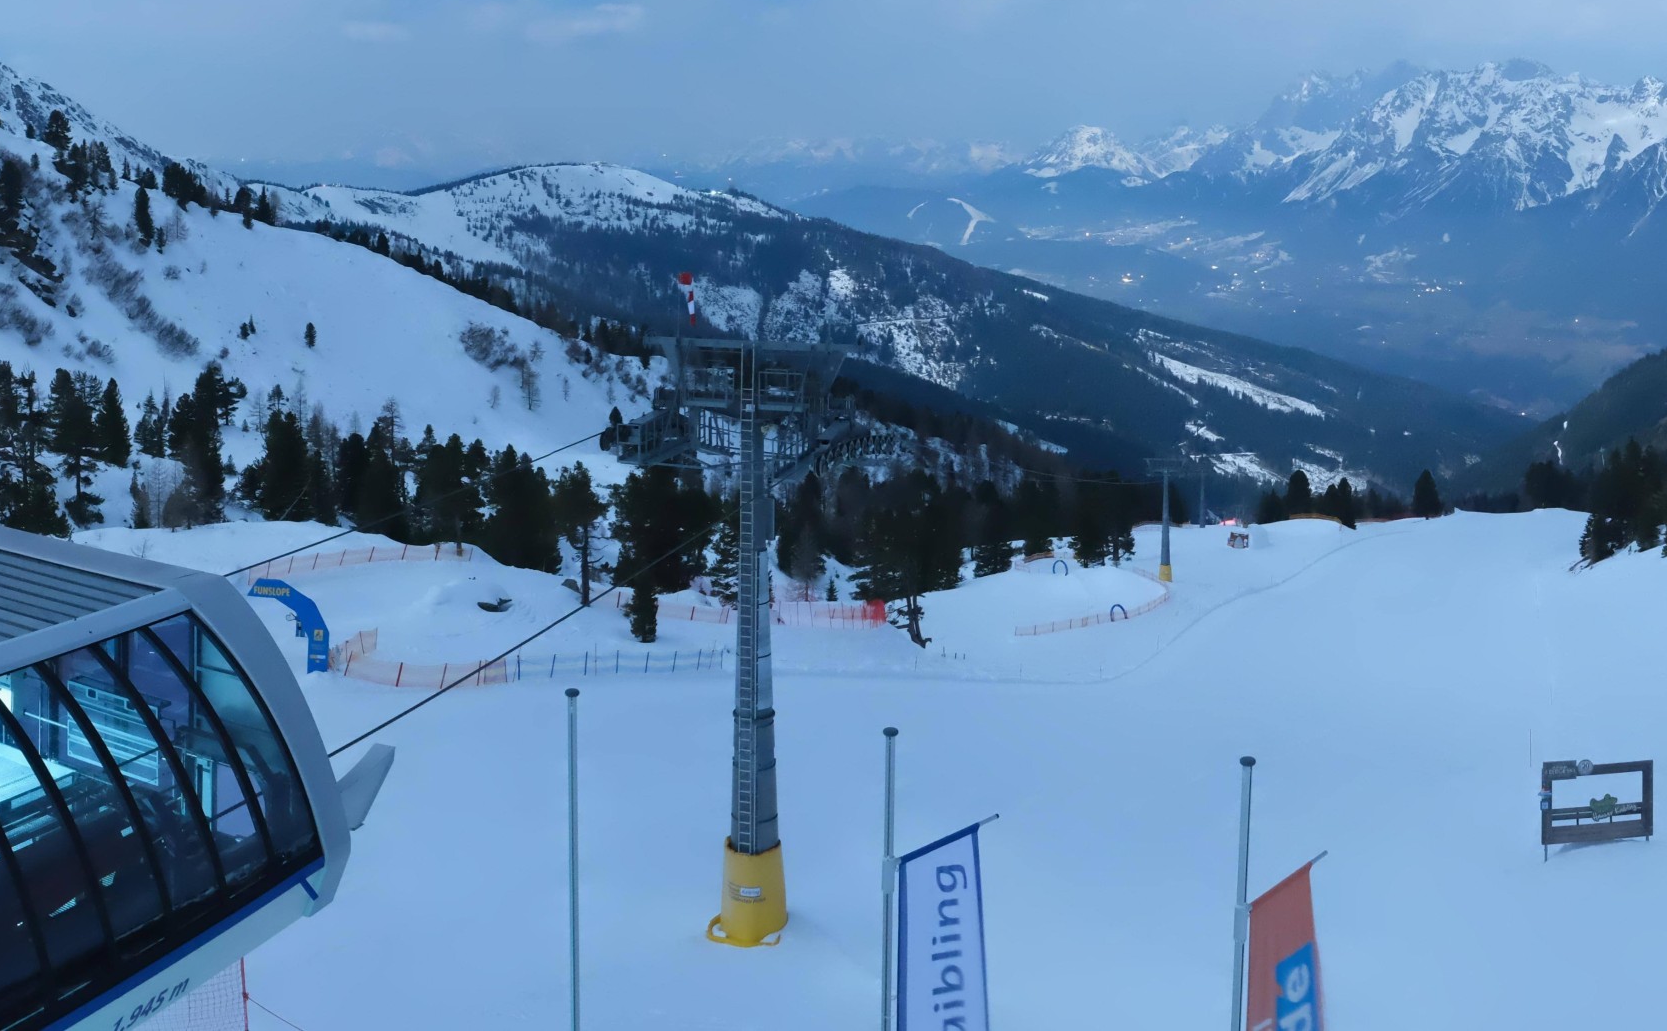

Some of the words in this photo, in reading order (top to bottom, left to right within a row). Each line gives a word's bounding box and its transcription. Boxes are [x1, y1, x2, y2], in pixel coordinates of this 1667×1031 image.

[253, 586, 290, 597] FUNSLOPE
[113, 988, 168, 1031] 1.945
[168, 977, 190, 1002] m
